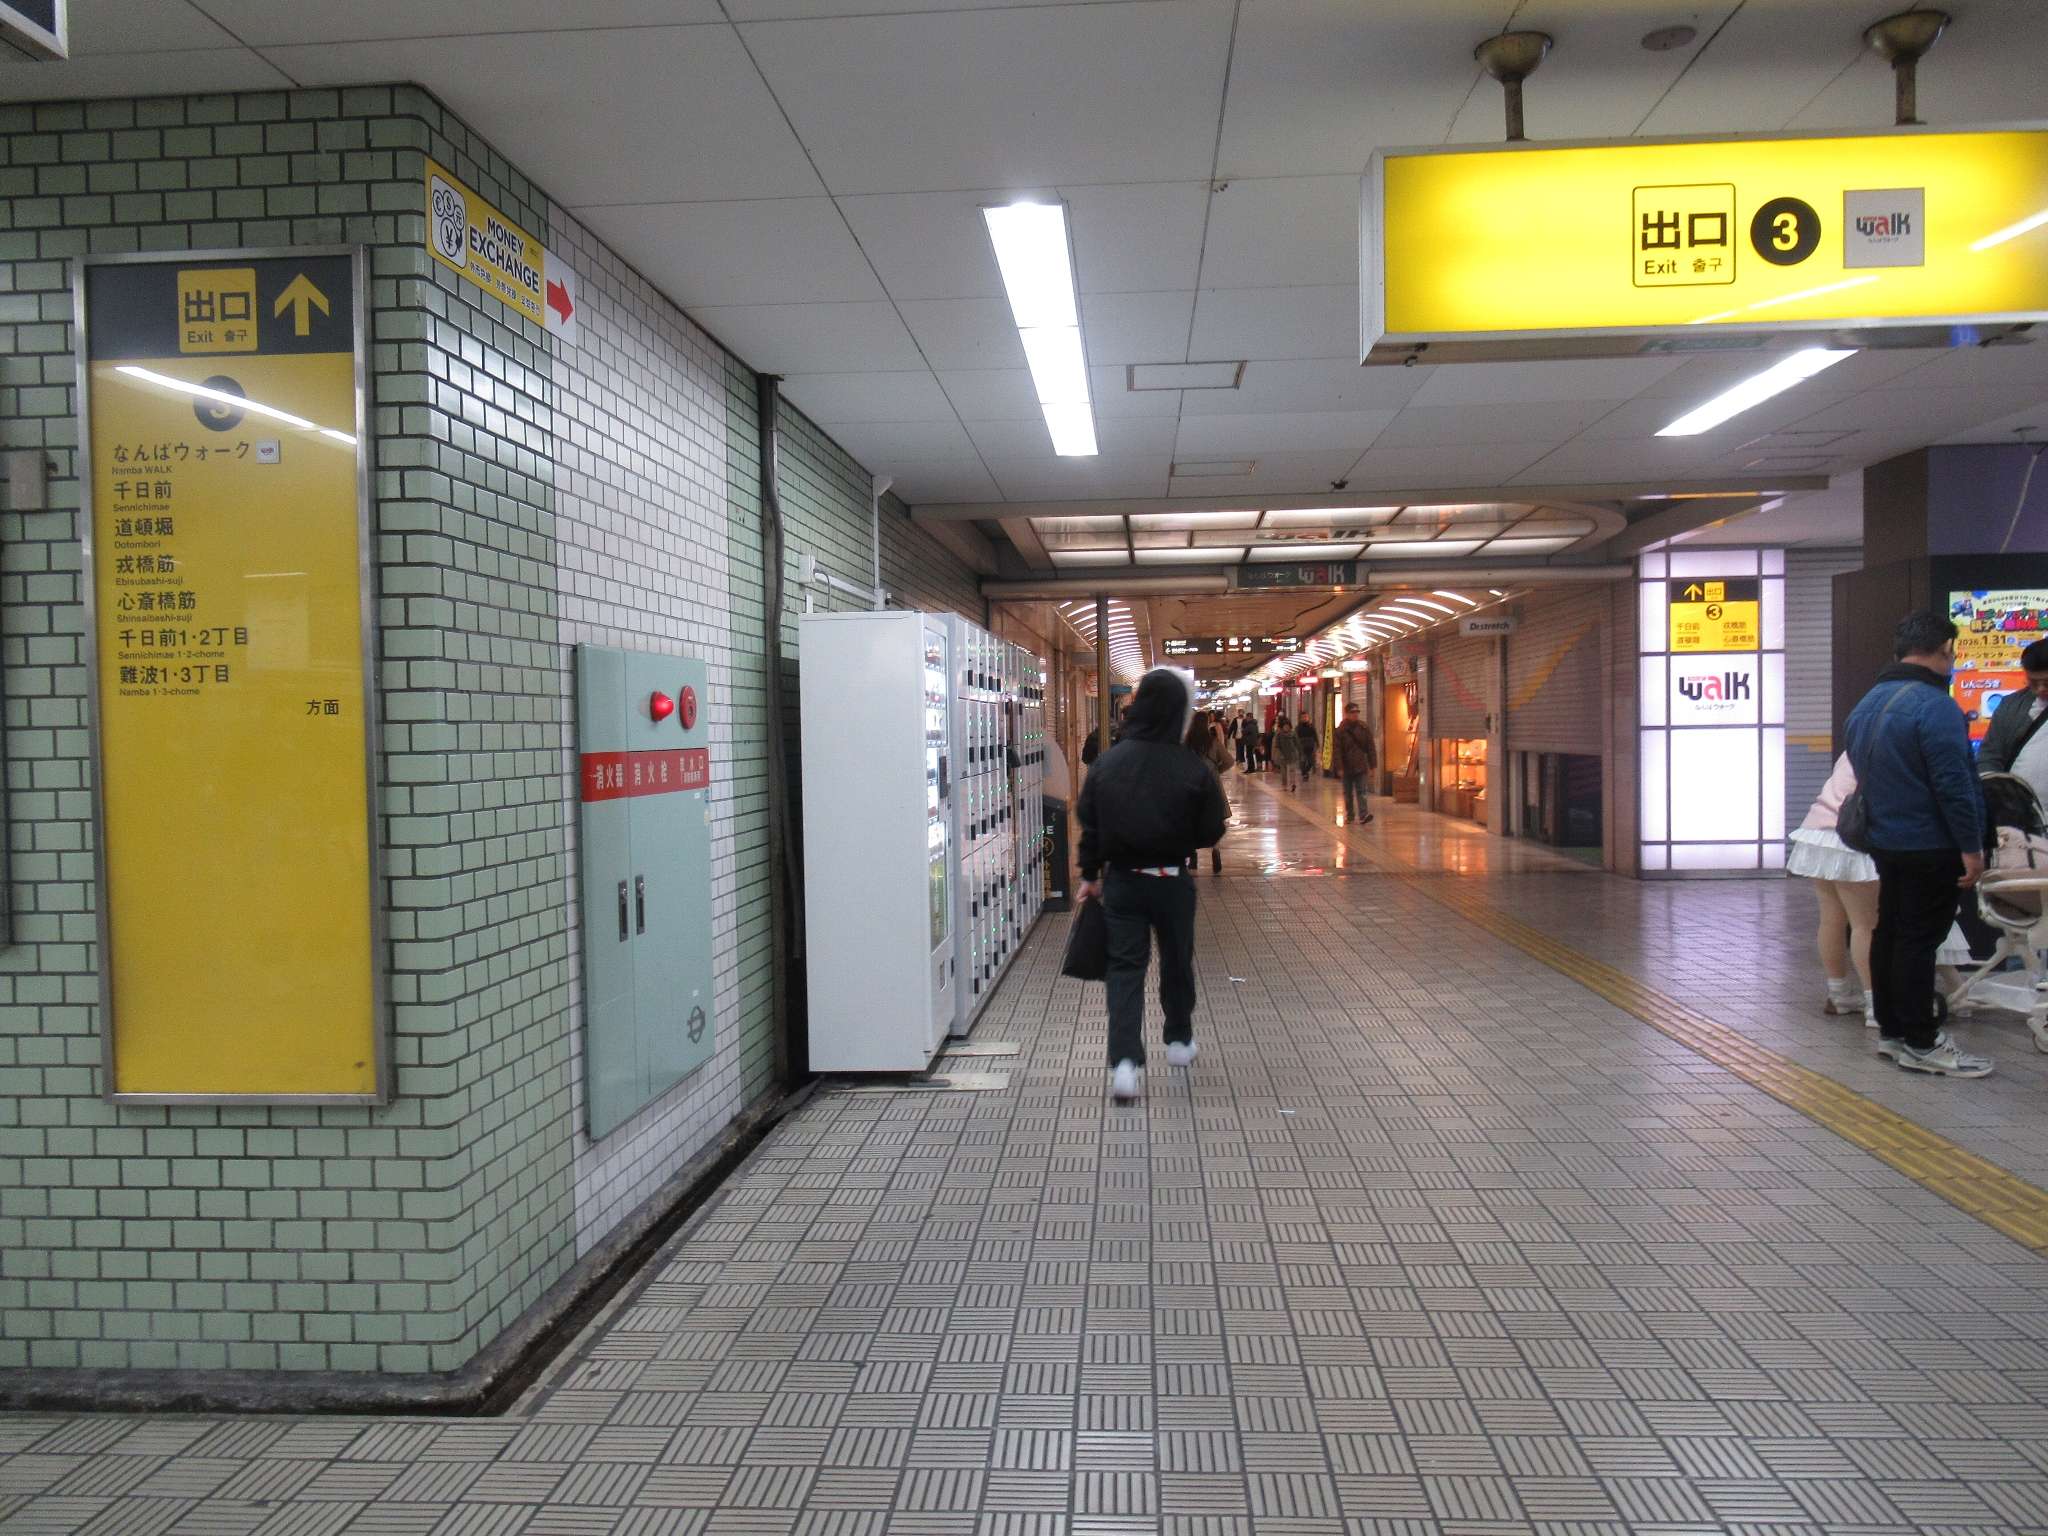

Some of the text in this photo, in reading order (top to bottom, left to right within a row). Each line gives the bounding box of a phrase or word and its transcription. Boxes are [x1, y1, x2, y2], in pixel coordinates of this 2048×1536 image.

[1641, 210, 1727, 251] 出口
[1770, 212, 1800, 251] 3
[1856, 212, 1911, 237] walk
[487, 216, 525, 257] MONEY
[468, 225, 540, 295] EXCHANGE
[1644, 259, 1677, 275] Exit
[1692, 257, 1722, 274] 출구
[184, 289, 251, 324] 出口
[187, 330, 214, 344] Exit
[223, 329, 248, 343] 출구
[113, 440, 250, 462] なんばウォーク
[112, 464, 172, 476] Namba WALK
[113, 481, 173, 500] 千日前
[113, 502, 169, 512] Sennichimae
[115, 517, 174, 537] 道頓堀
[114, 539, 160, 549] Dotombori
[115, 554, 175, 574] 戎橋筋
[115, 577, 183, 586] Ebisubashi-suji
[1297, 563, 1345, 585] walk
[116, 614, 192, 624] Shinsaibashi-suji
[1708, 605, 1721, 620] 3
[118, 650, 174, 660] Sennichimae
[119, 688, 149, 697] Namba
[1678, 671, 1751, 701] walk
[305, 699, 340, 717] 方面
